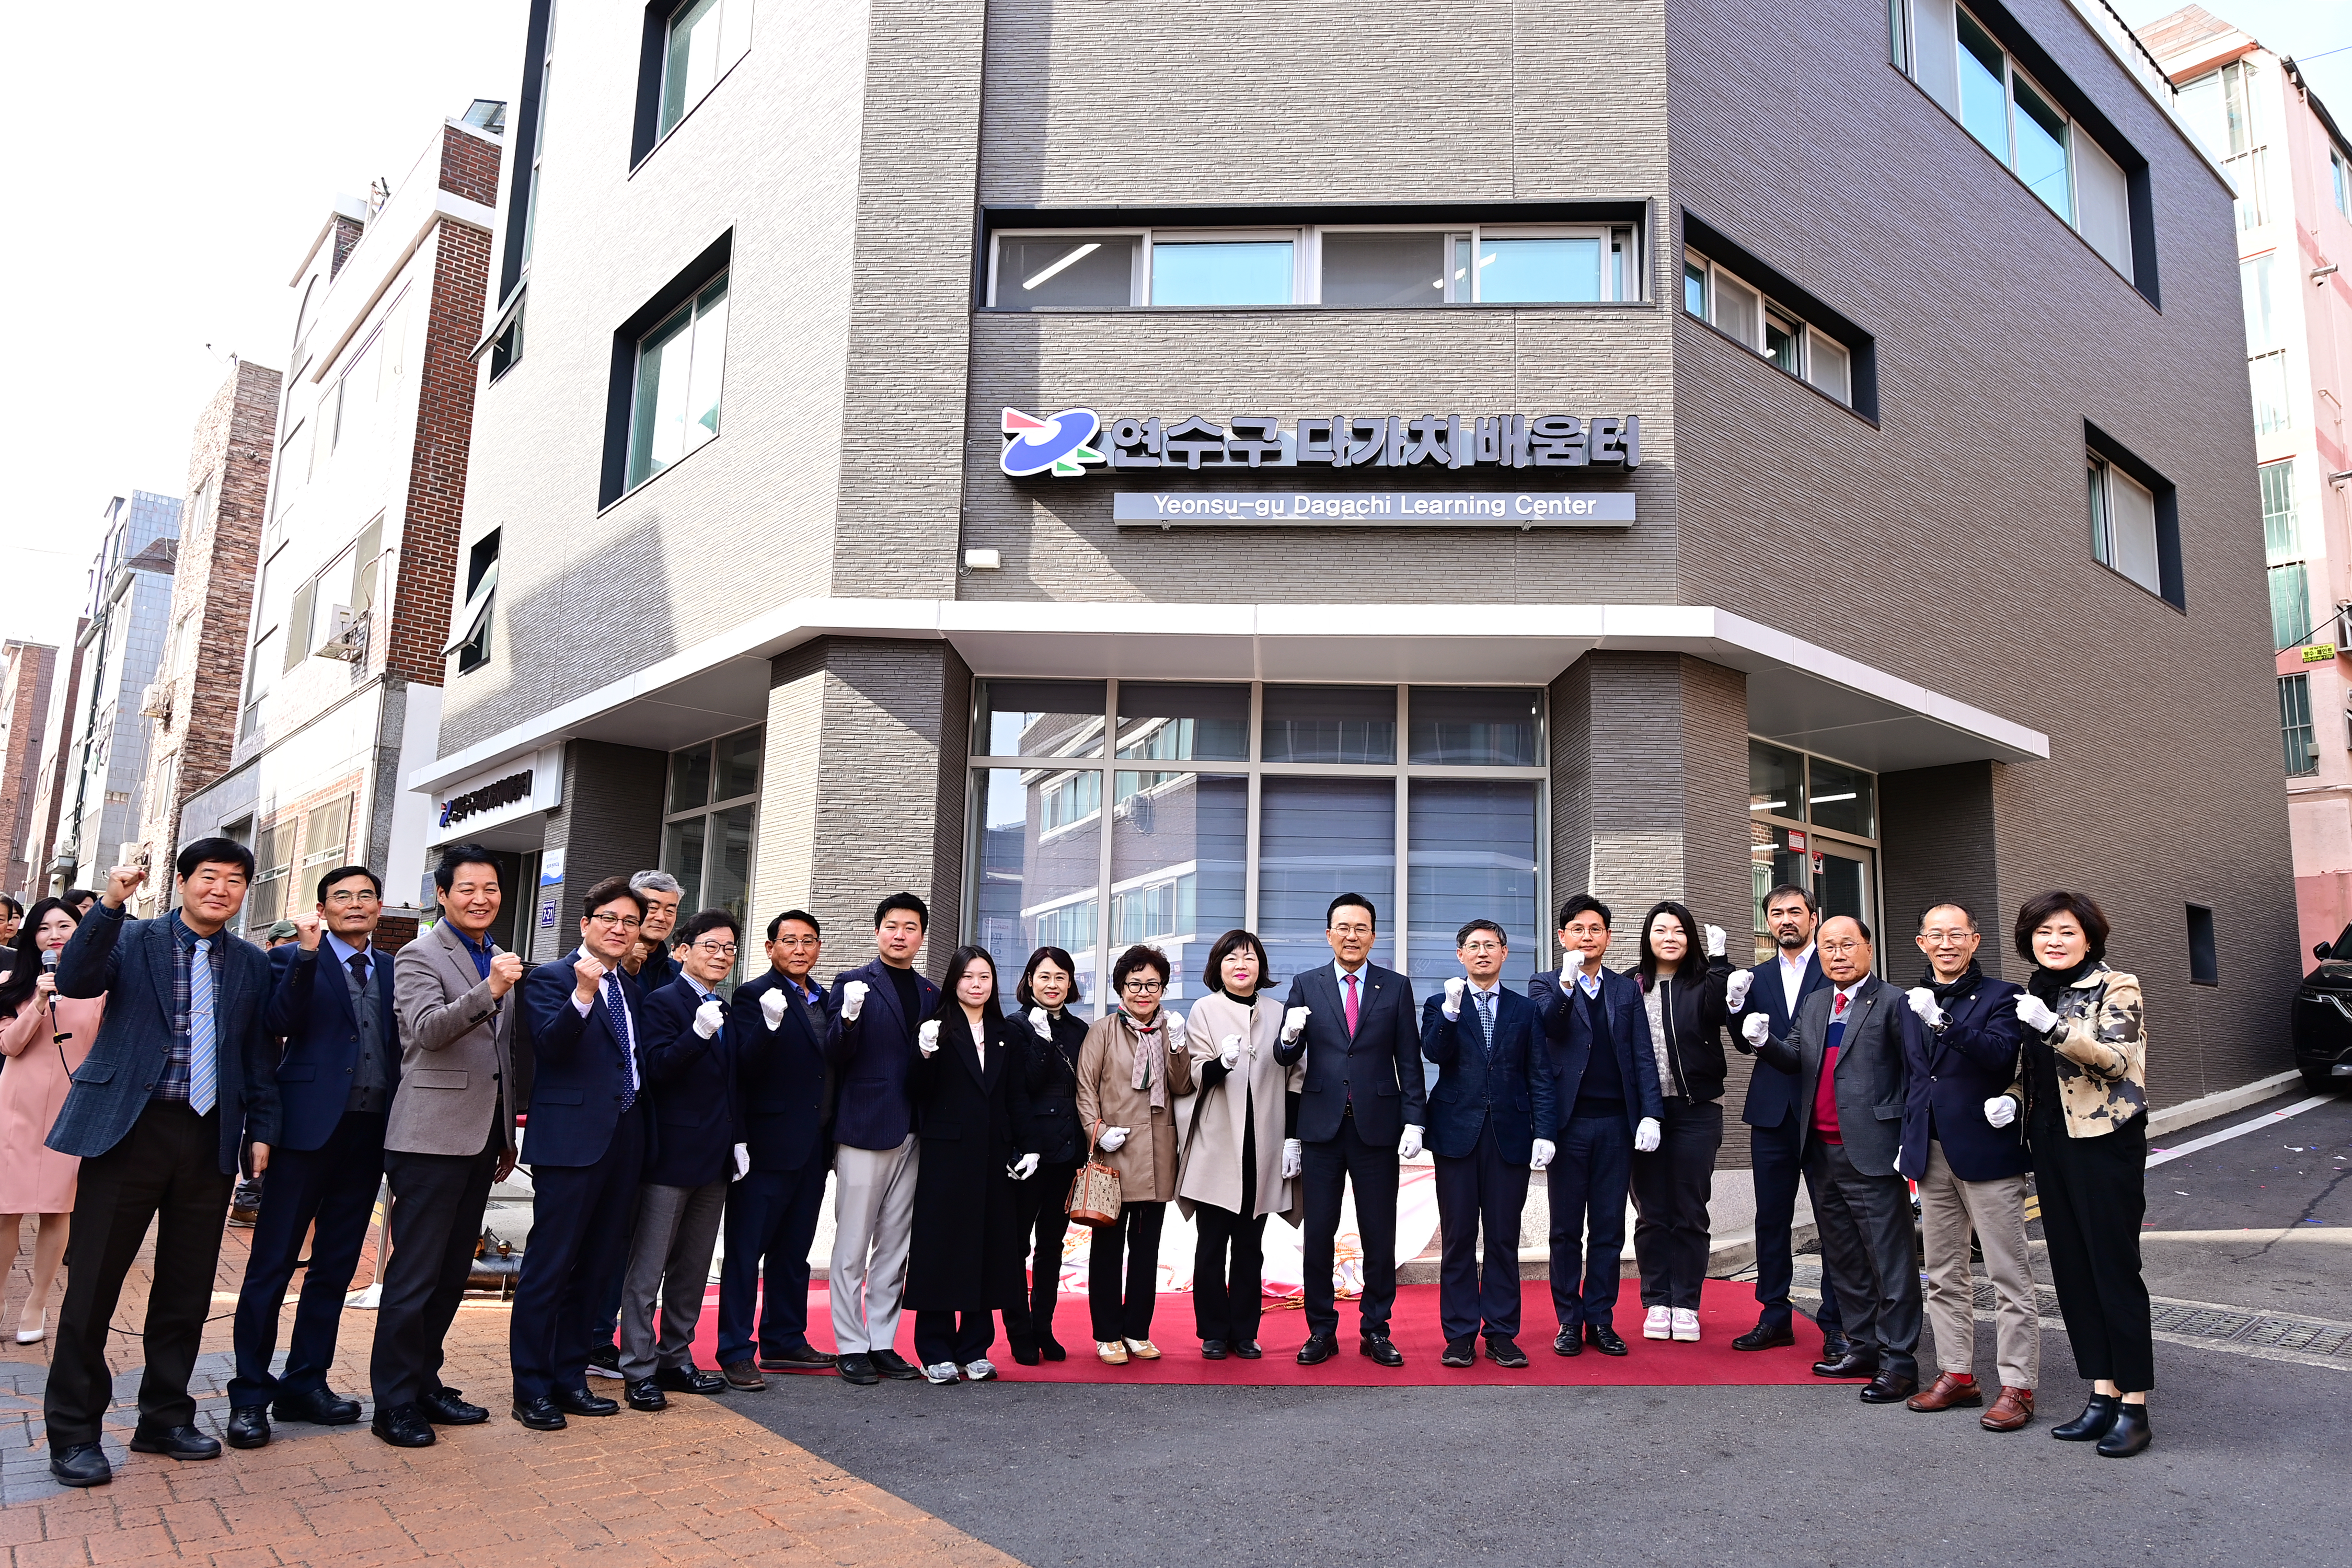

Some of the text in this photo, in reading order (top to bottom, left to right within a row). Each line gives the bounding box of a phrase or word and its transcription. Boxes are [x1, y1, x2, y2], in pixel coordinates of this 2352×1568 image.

[1109, 413, 1641, 471] 연수구 다가치 배움터
[1154, 494, 1597, 517] Yeonsu-gu Dagachi Learning Center
[543, 908, 553, 920] 7-21
